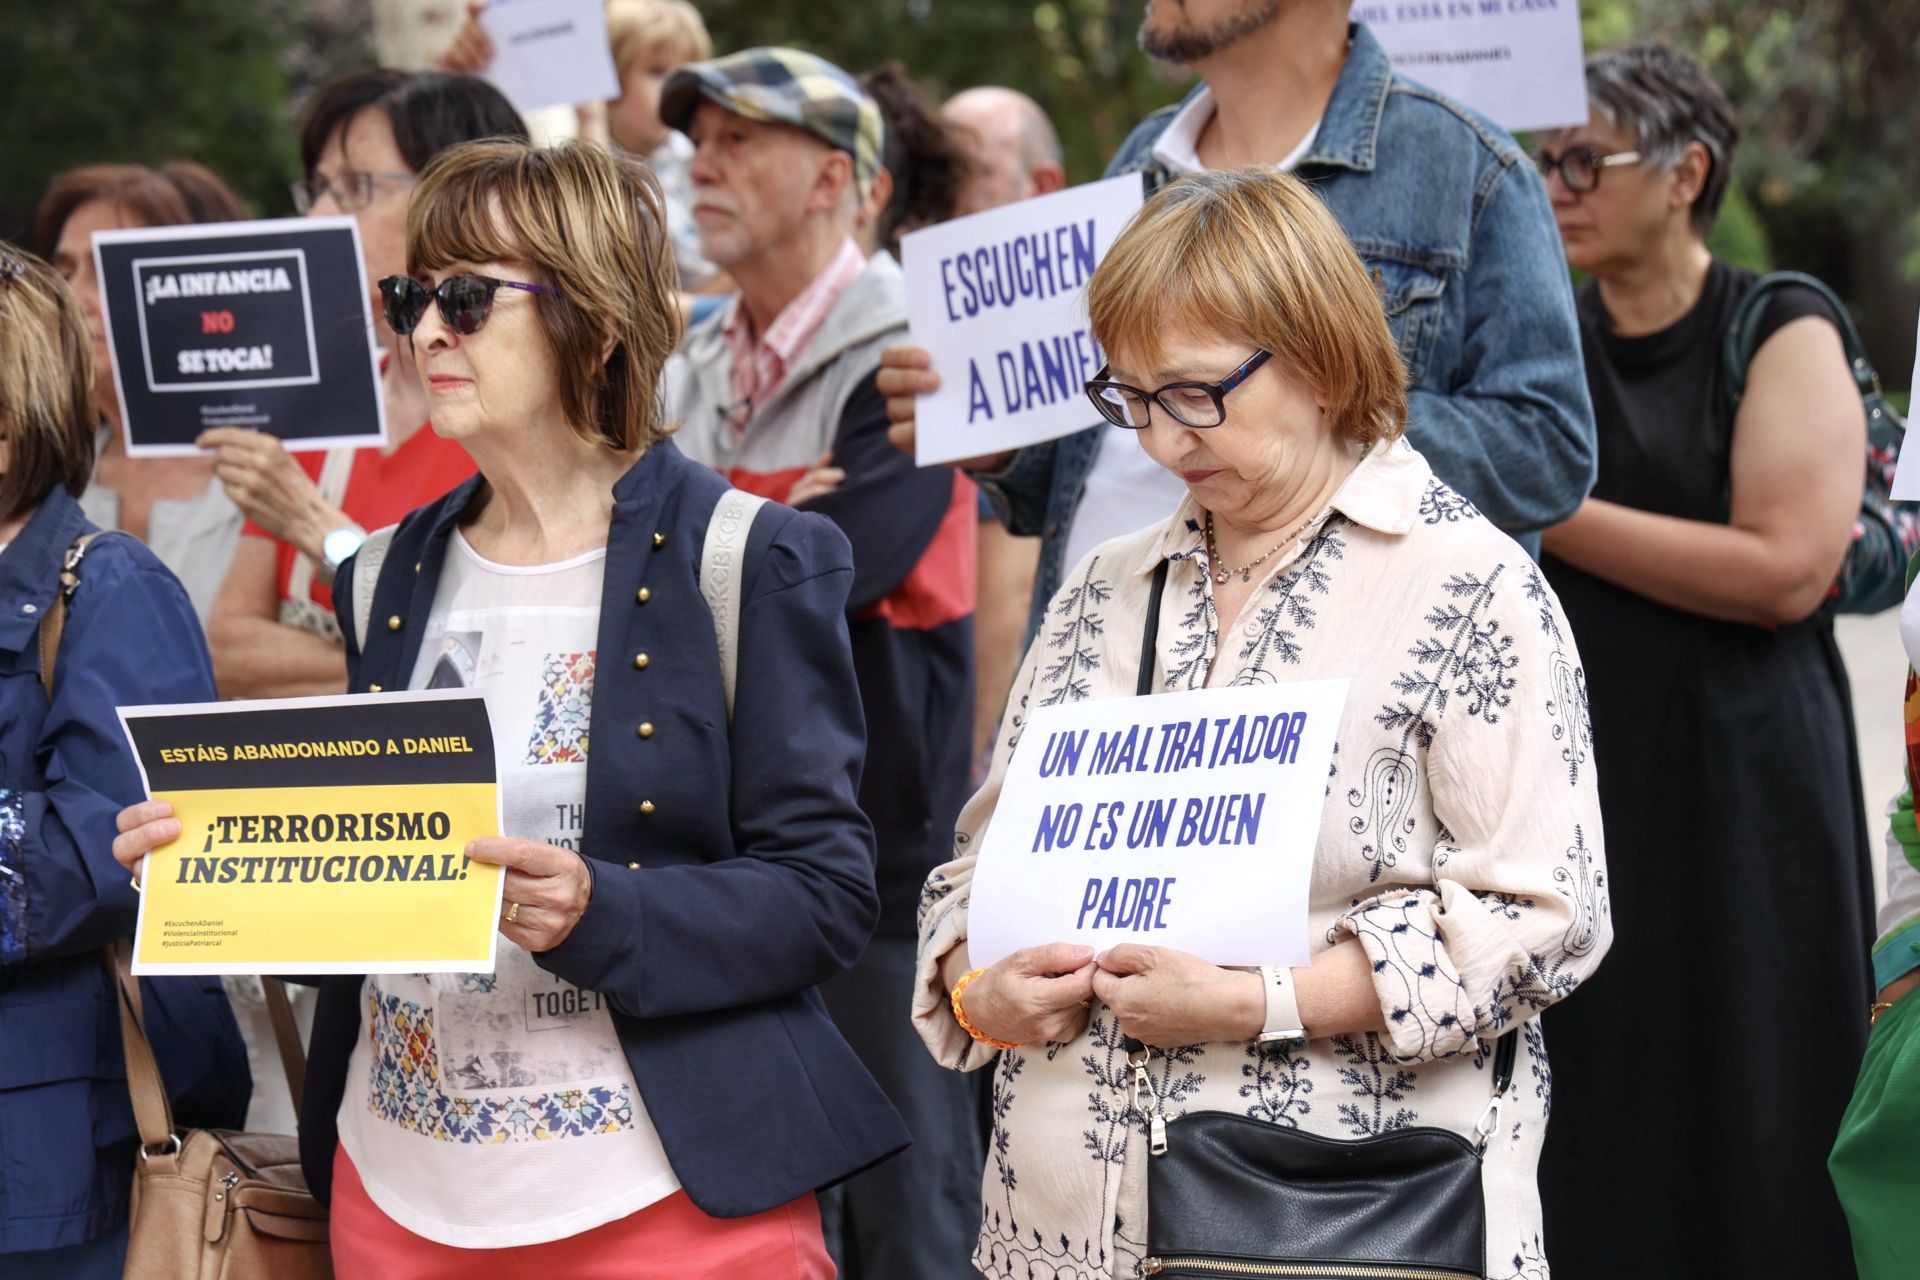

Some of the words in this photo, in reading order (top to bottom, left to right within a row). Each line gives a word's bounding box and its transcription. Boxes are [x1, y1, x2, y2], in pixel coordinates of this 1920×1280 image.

[1448, 2, 1472, 17] EN
[1481, 0, 1503, 15] MI
[181, 267, 292, 298] INFANCIA
[940, 219, 1096, 322] ESCUCHEN
[200, 310, 235, 335] NO
[177, 349, 205, 374] SE
[206, 344, 274, 373] TOCA!
[968, 358, 994, 425] A
[160, 744, 228, 764] ESTÁIS
[233, 739, 380, 761] ABANDONANDO
[386, 738, 401, 755] A
[403, 736, 473, 755] DANIEL
[1039, 729, 1089, 778] UN
[1088, 711, 1307, 775] MALTRATADOR
[203, 811, 450, 853] ¡TERRORISMO
[1031, 803, 1083, 853] NO
[1084, 801, 1124, 851] ES
[1126, 797, 1177, 850] UN
[1176, 793, 1266, 847] BUEN
[176, 854, 471, 884] INSTITUCIONAL!
[1076, 877, 1176, 931] PADRE
[163, 929, 238, 938] #ViolenciaInstitucional
[164, 919, 224, 928] #EscuchenADaniel
[162, 939, 222, 949] #JusticiaPatriarcal
